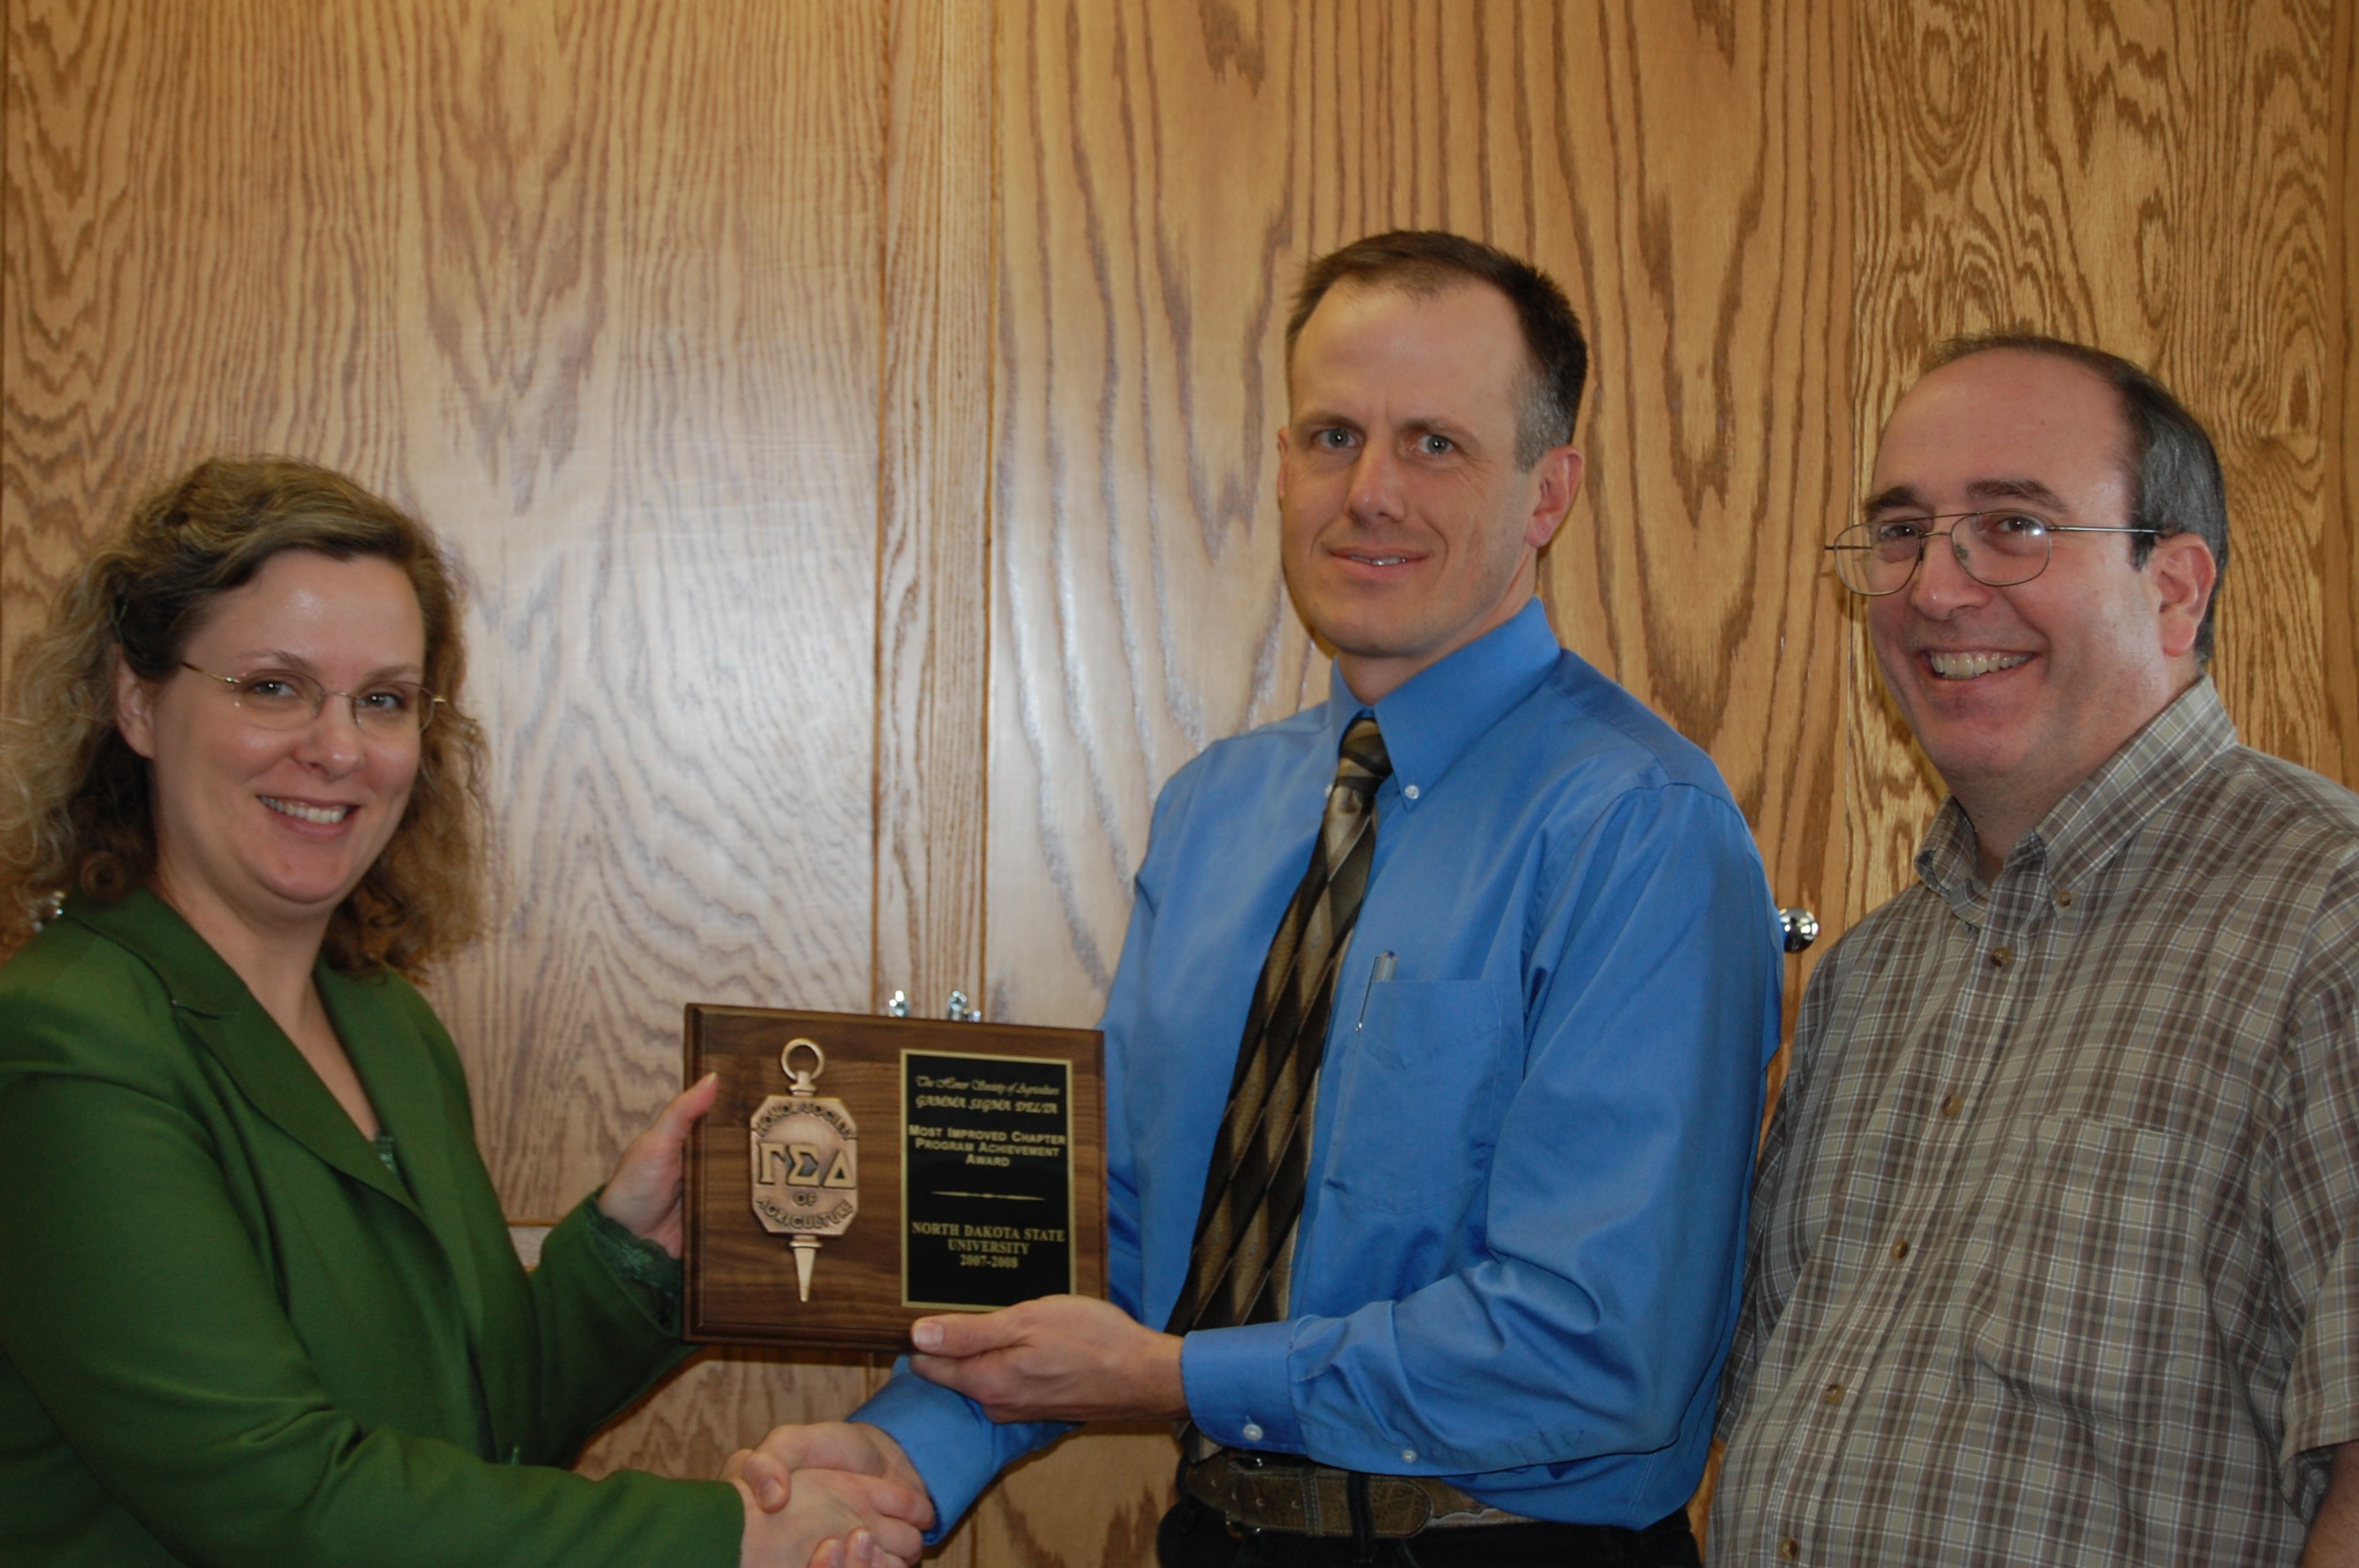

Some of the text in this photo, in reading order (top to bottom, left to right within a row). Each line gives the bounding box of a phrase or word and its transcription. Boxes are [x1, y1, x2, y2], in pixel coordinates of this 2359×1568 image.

[965, 1154, 1010, 1167] AWARD
[792, 1191, 816, 1207] OF
[756, 1196, 853, 1229] AGRICULTURE
[912, 1221, 1065, 1242] NORTH DAKOTA STATE
[947, 1239, 1030, 1254] UNIVERSITY
[960, 1254, 1018, 1269] 2007-2008
